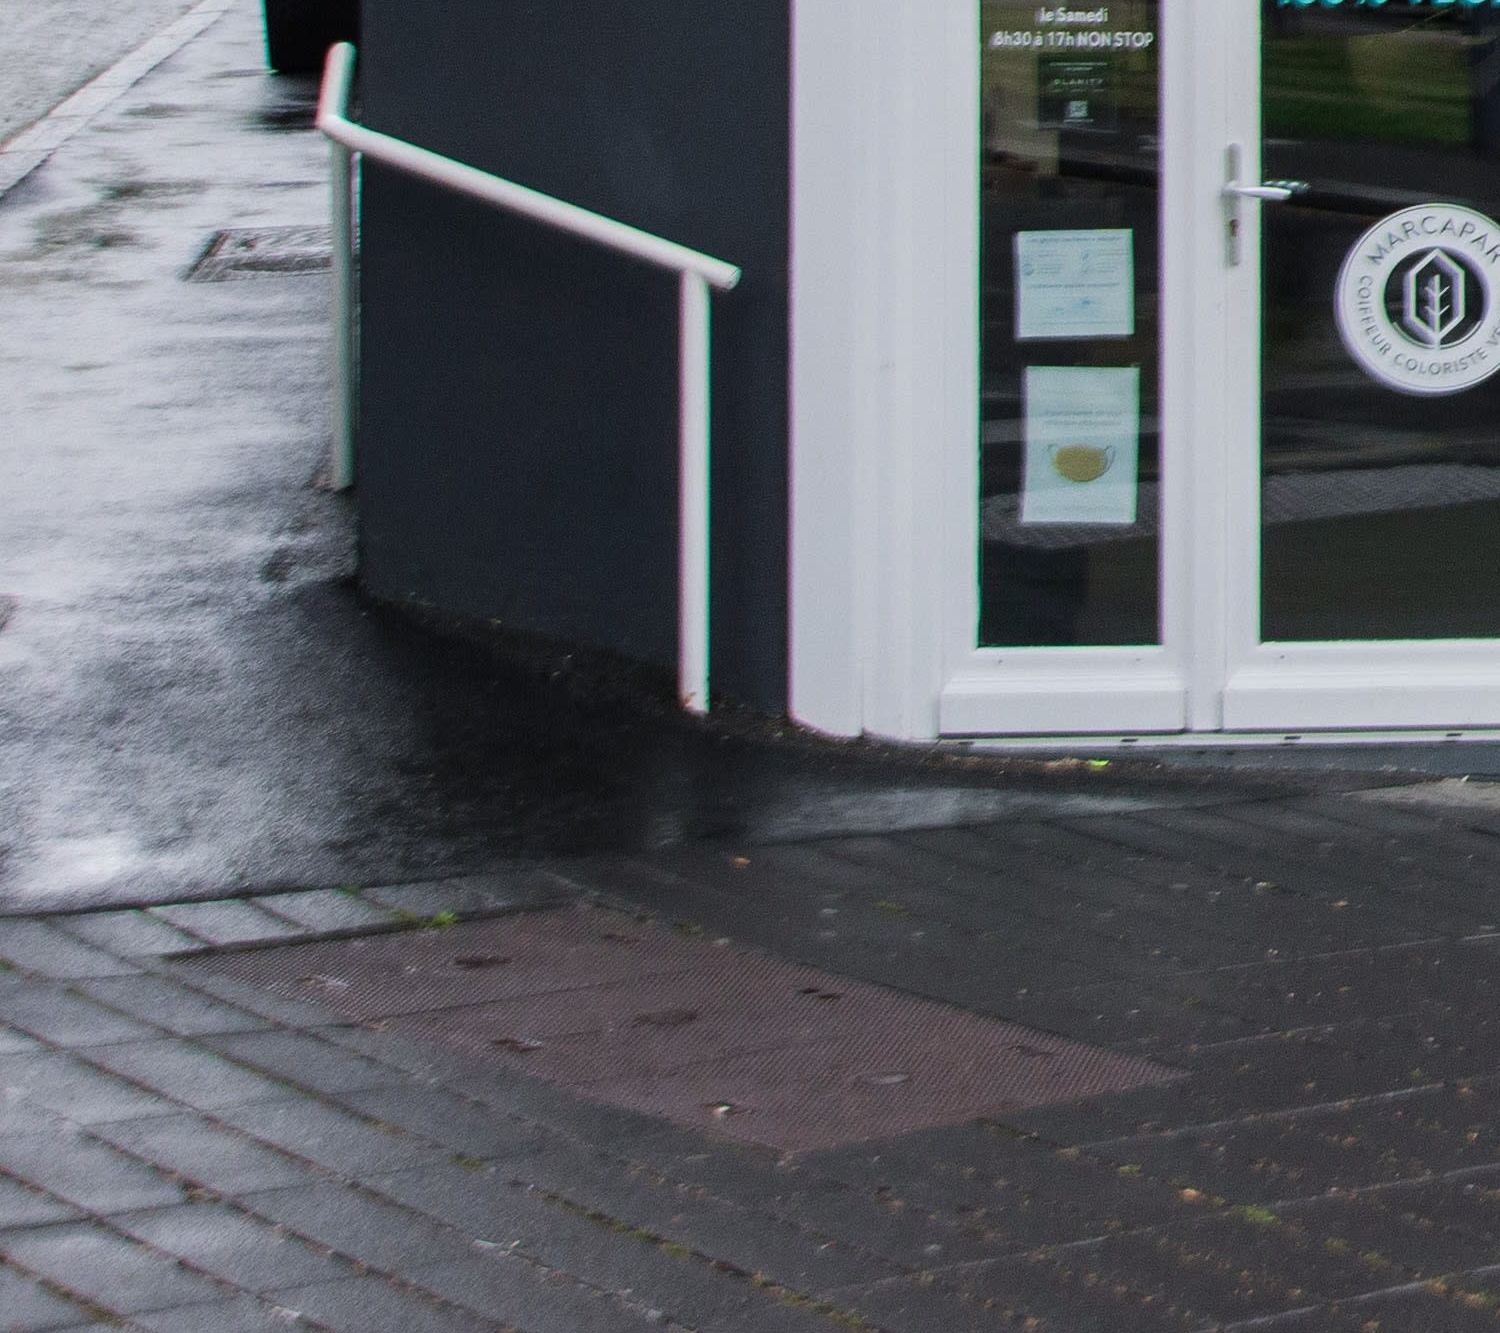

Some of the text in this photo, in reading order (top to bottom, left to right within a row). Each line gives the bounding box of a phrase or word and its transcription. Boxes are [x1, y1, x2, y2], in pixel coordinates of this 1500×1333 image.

[1039, 7, 1109, 23] le Samedi
[993, 31, 1031, 46] 8h30
[1047, 31, 1075, 46] 17h
[1077, 31, 1112, 47] NON
[1113, 31, 1154, 48] STOP
[1356, 274, 1393, 356] COIFFEUR
[1393, 346, 1489, 377] COLORISTE
